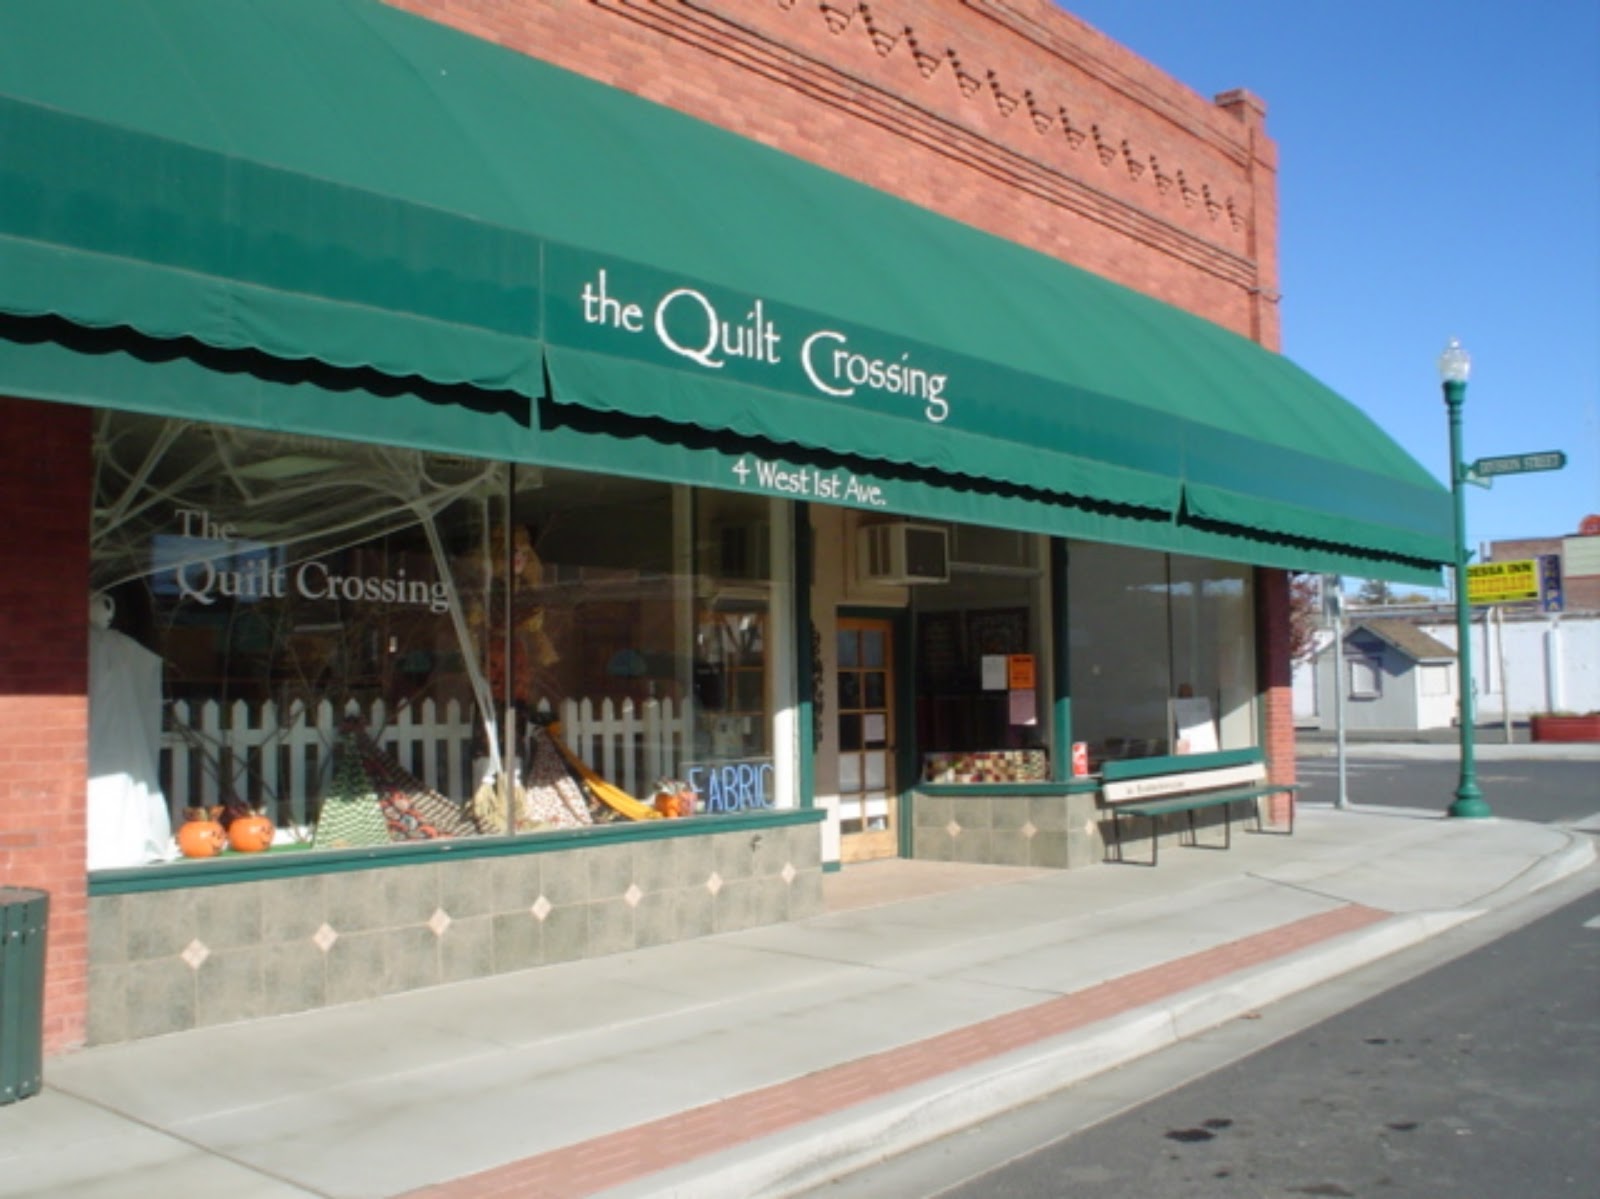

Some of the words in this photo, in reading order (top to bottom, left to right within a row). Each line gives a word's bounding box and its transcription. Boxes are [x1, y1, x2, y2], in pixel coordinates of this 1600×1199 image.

[582, 269, 643, 332] the
[655, 288, 780, 368] Quilt
[802, 331, 949, 422] Crossing
[732, 458, 750, 485] 4
[755, 460, 809, 492] West
[843, 475, 887, 505] Ave.
[175, 508, 237, 542] The
[175, 556, 286, 605] Quilt
[296, 561, 450, 611] Crossing
[688, 763, 775, 814] FABRIC
